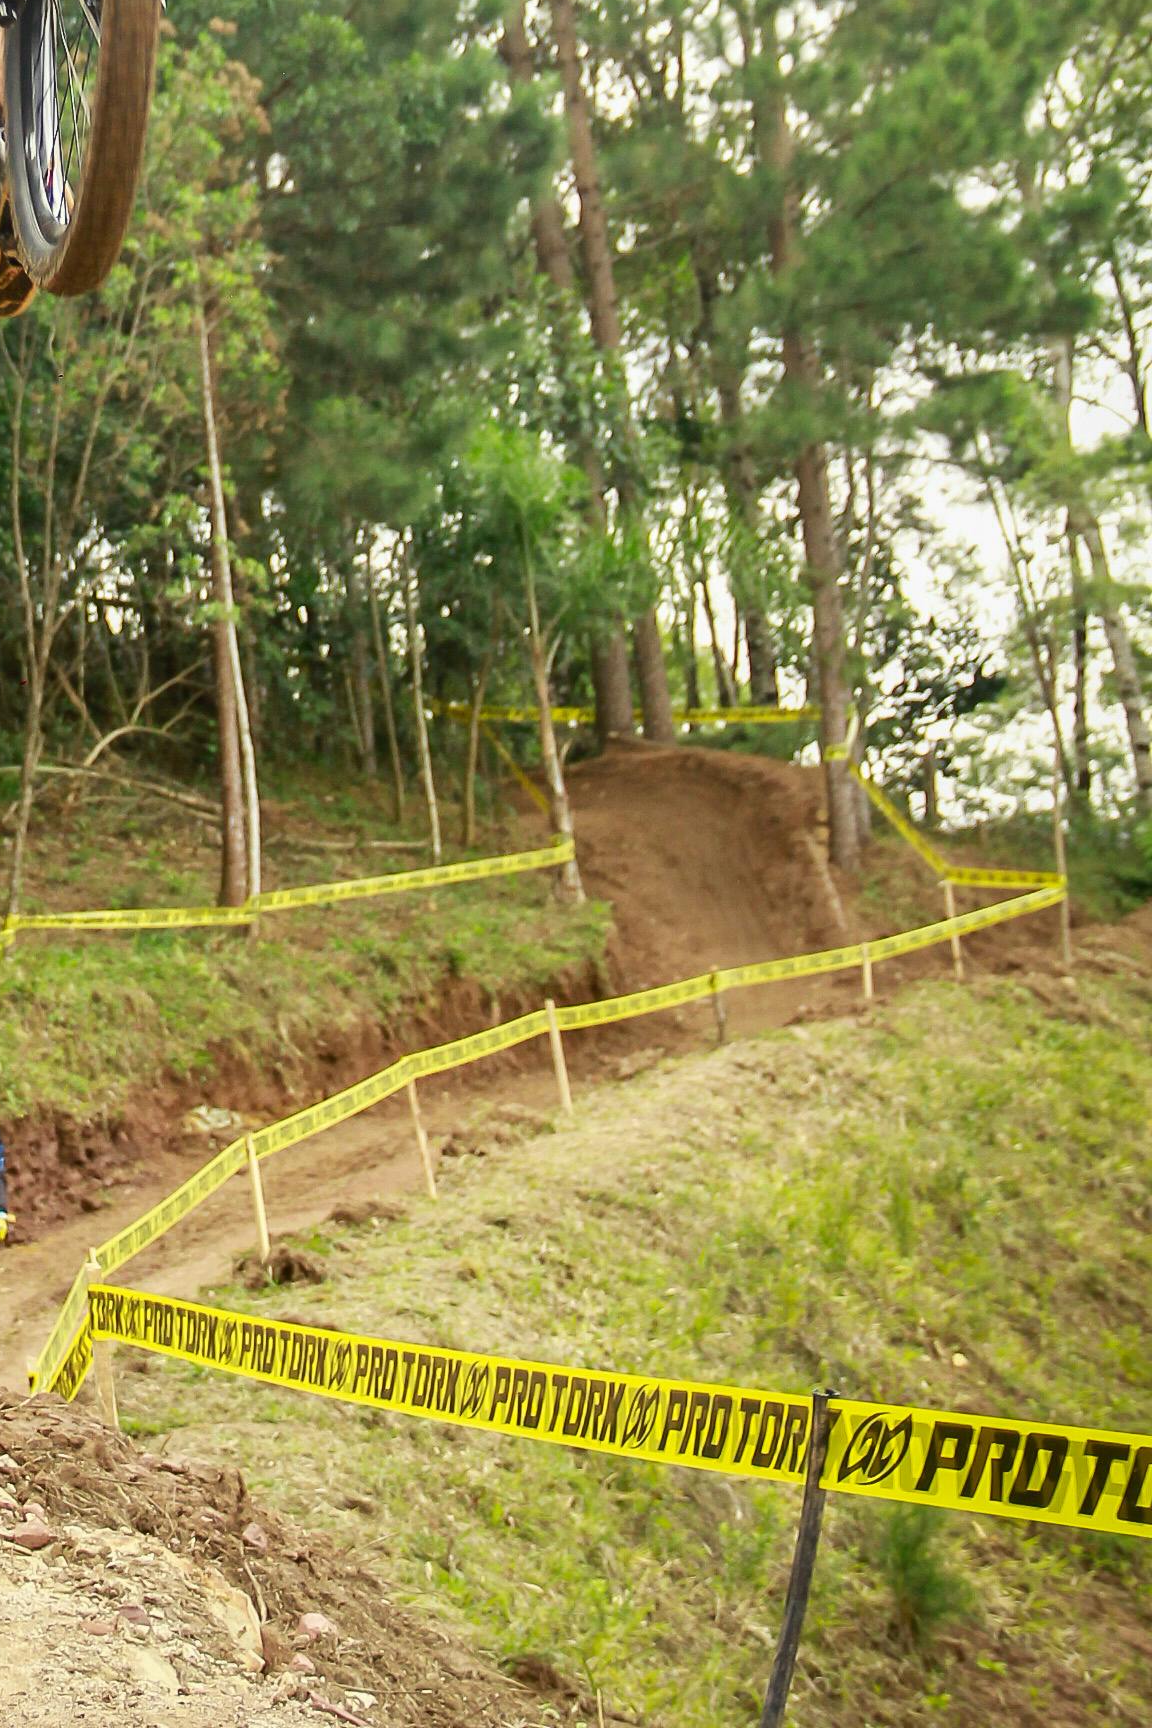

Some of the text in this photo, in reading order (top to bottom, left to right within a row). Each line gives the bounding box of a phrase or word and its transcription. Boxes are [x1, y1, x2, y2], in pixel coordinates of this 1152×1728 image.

[88, 1290, 125, 1335] TORK
[143, 1299, 174, 1347] PRO
[175, 1307, 219, 1360] TORK
[239, 1322, 276, 1374] PRO
[279, 1329, 329, 1386] TORK
[352, 1343, 398, 1400] PRO
[401, 1351, 462, 1414] TORK
[489, 1366, 547, 1429] PRO
[549, 1373, 626, 1443] TORK
[658, 1389, 733, 1459] PRO
[915, 1421, 1069, 1509] PRO
